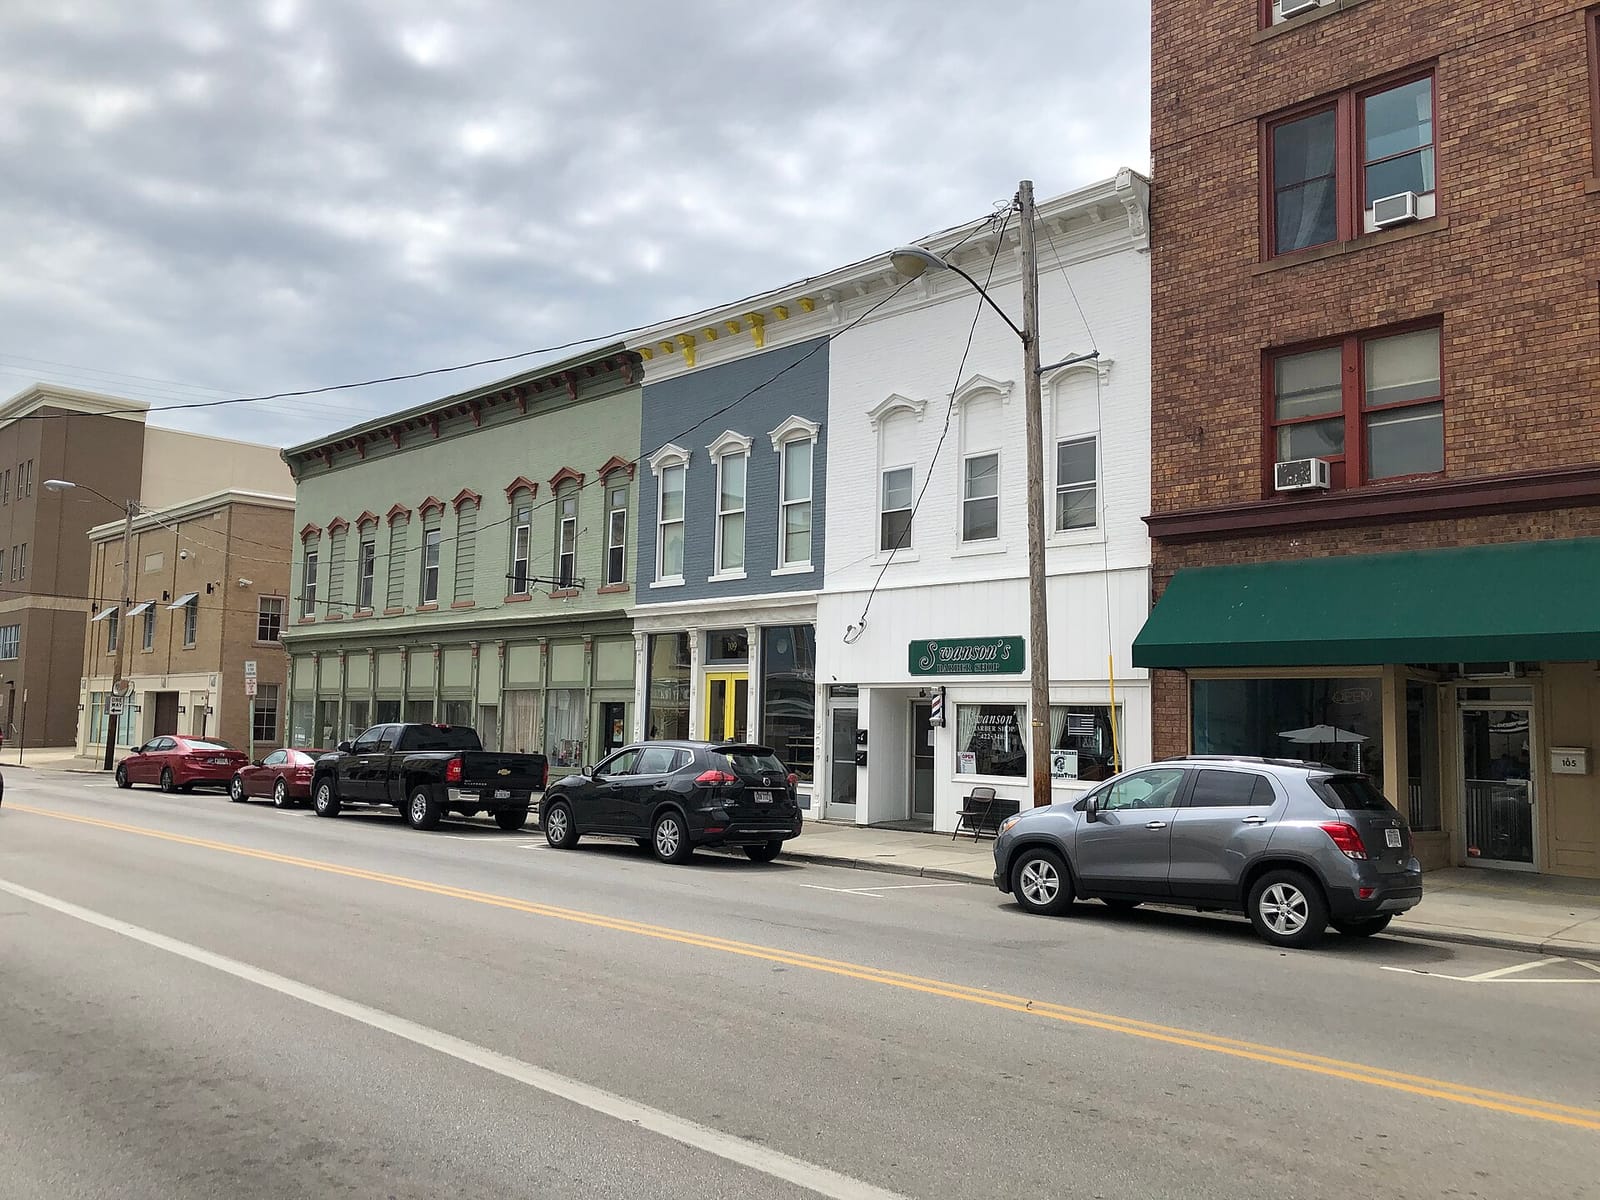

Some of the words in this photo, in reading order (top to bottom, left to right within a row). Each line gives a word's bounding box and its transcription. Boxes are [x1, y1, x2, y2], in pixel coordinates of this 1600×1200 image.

[919, 639, 1011, 671] Swanson's
[936, 663, 973, 673] BARBER
[974, 662, 1000, 673] SHOP
[1562, 757, 1577, 767] 105
